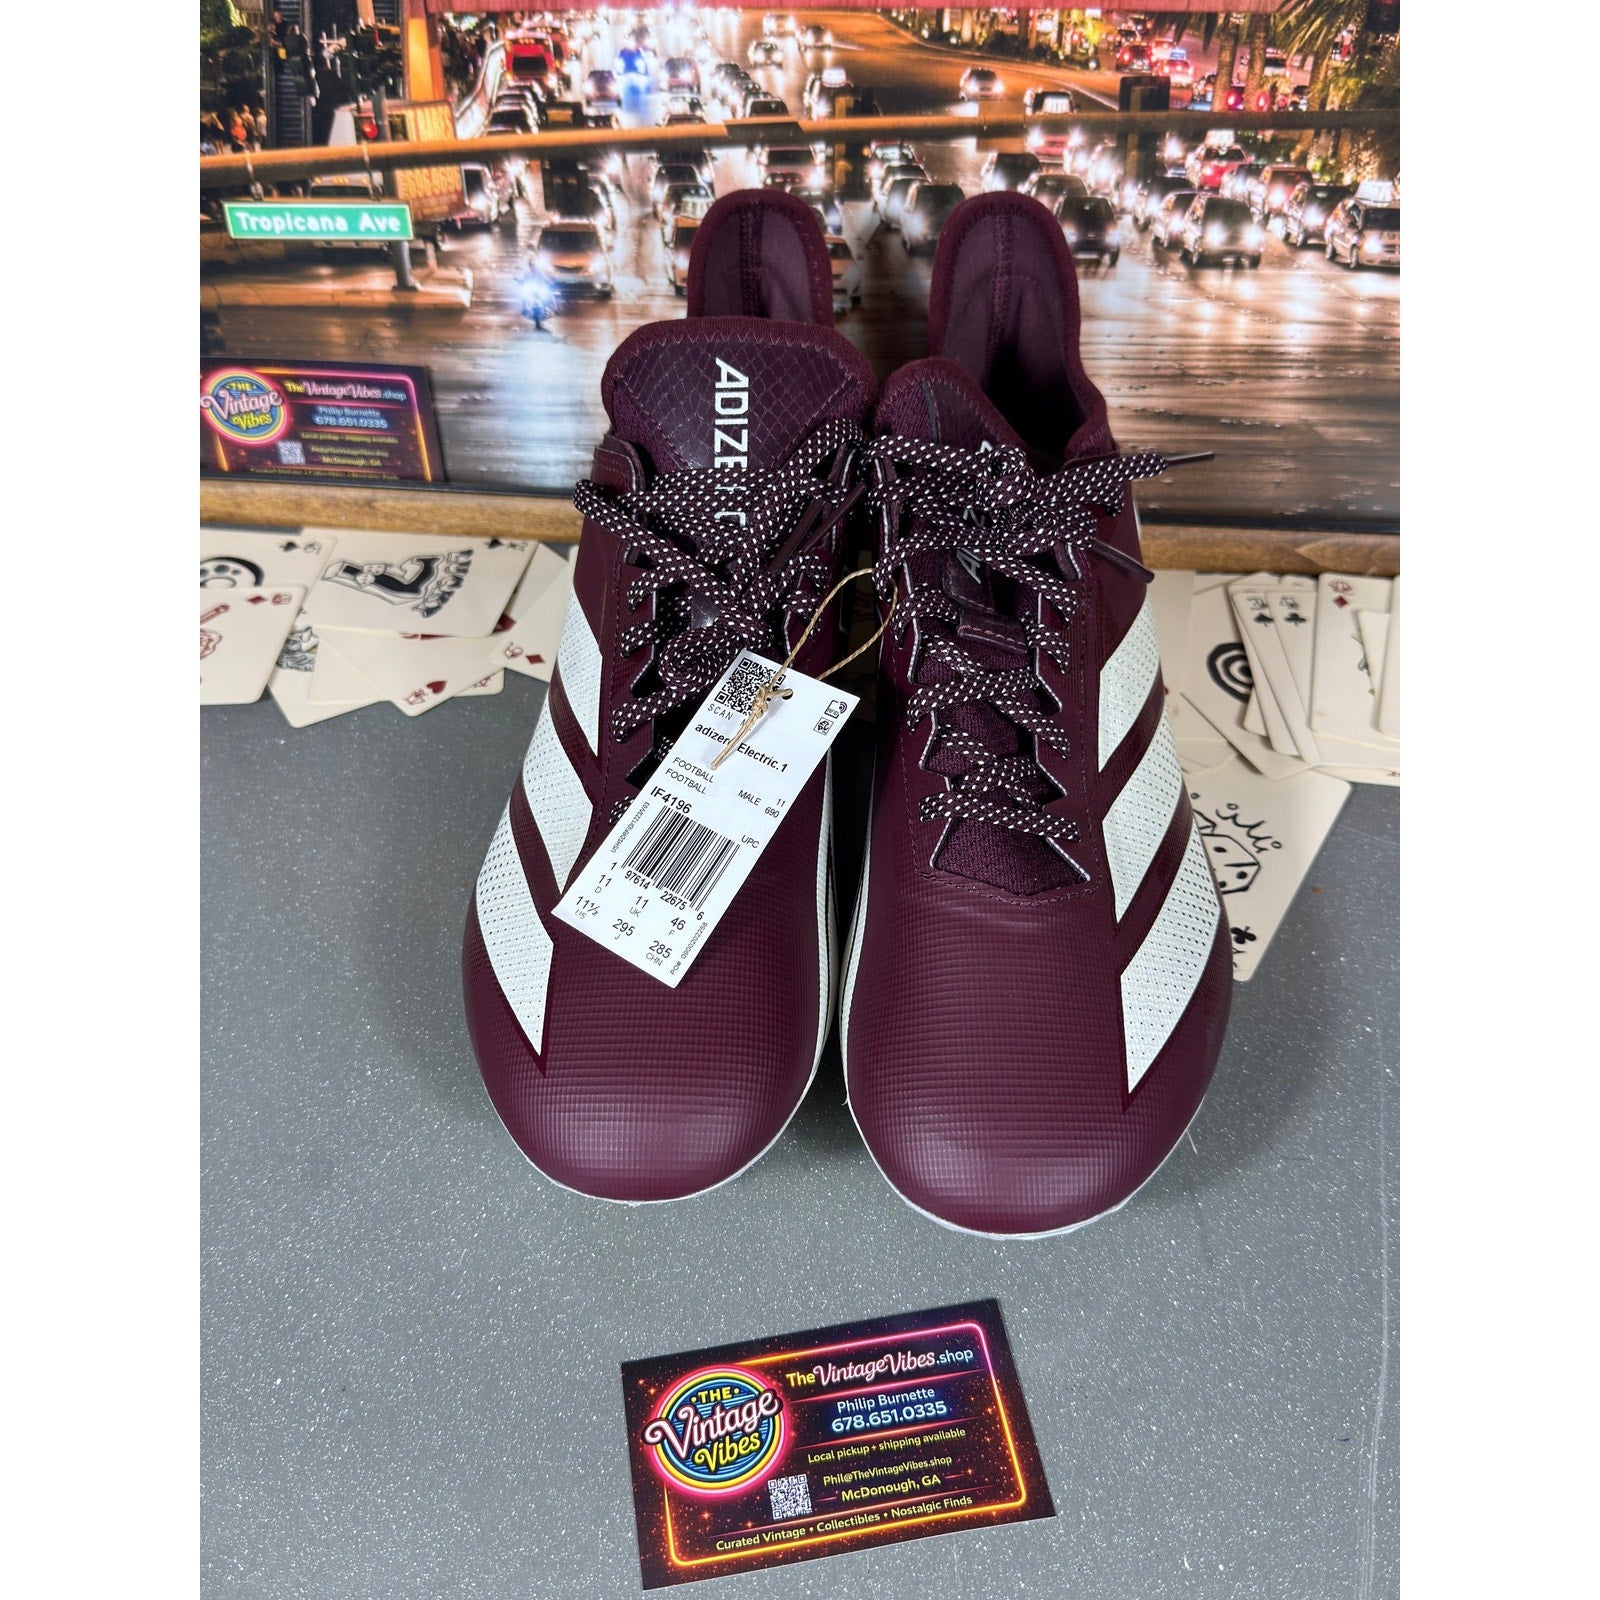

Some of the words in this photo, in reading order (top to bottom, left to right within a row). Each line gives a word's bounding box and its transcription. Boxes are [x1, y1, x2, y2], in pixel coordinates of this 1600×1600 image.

[235, 211, 349, 234] Tropicana
[359, 211, 401, 232] Ave
[200, 388, 282, 420] Vintage
[231, 412, 273, 430] Vibes
[714, 357, 748, 527] ADIZE
[708, 703, 733, 720] SCAN
[672, 757, 714, 783] FOOTBALL
[737, 742, 788, 772] Electric.1
[650, 786, 692, 814] IF4196
[665, 768, 707, 794] FOOTBALL
[738, 789, 761, 806] MALE
[776, 798, 786, 807] 11
[764, 806, 780, 818] 690
[741, 834, 760, 849] UPC
[599, 874, 612, 887] 11
[635, 896, 649, 909] 11
[670, 917, 686, 931] 46
[624, 870, 651, 890] 97614
[660, 890, 687, 910] 22675
[696, 911, 705, 921] 6
[594, 886, 602, 894] D
[629, 907, 642, 918] UK
[668, 929, 675, 937] F
[612, 918, 635, 936] 295
[649, 940, 672, 959] 285
[645, 952, 663, 967] CHN
[785, 1349, 974, 1388] TheVintageVibes.shop
[698, 1387, 732, 1403] THE
[836, 1396, 876, 1414] Philip
[877, 1387, 935, 1407] Burnette
[645, 1390, 779, 1458] Vintage
[831, 1400, 948, 1432] 678.651.0335
[694, 1432, 760, 1472] Vibes
[807, 1449, 835, 1463] Local
[836, 1444, 870, 1460] pickup
[878, 1435, 922, 1451] shipping
[922, 1428, 966, 1443] available
[823, 1455, 952, 1486] Phil@TheVintageVibes.shop
[841, 1478, 920, 1502] McDonough,
[921, 1474, 941, 1487] GA
[716, 1534, 760, 1551] Curated
[761, 1527, 807, 1544] Vintage
[816, 1512, 881, 1533] Collectibles
[890, 1501, 942, 1519] Nostalgic
[943, 1495, 973, 1509] Finds
